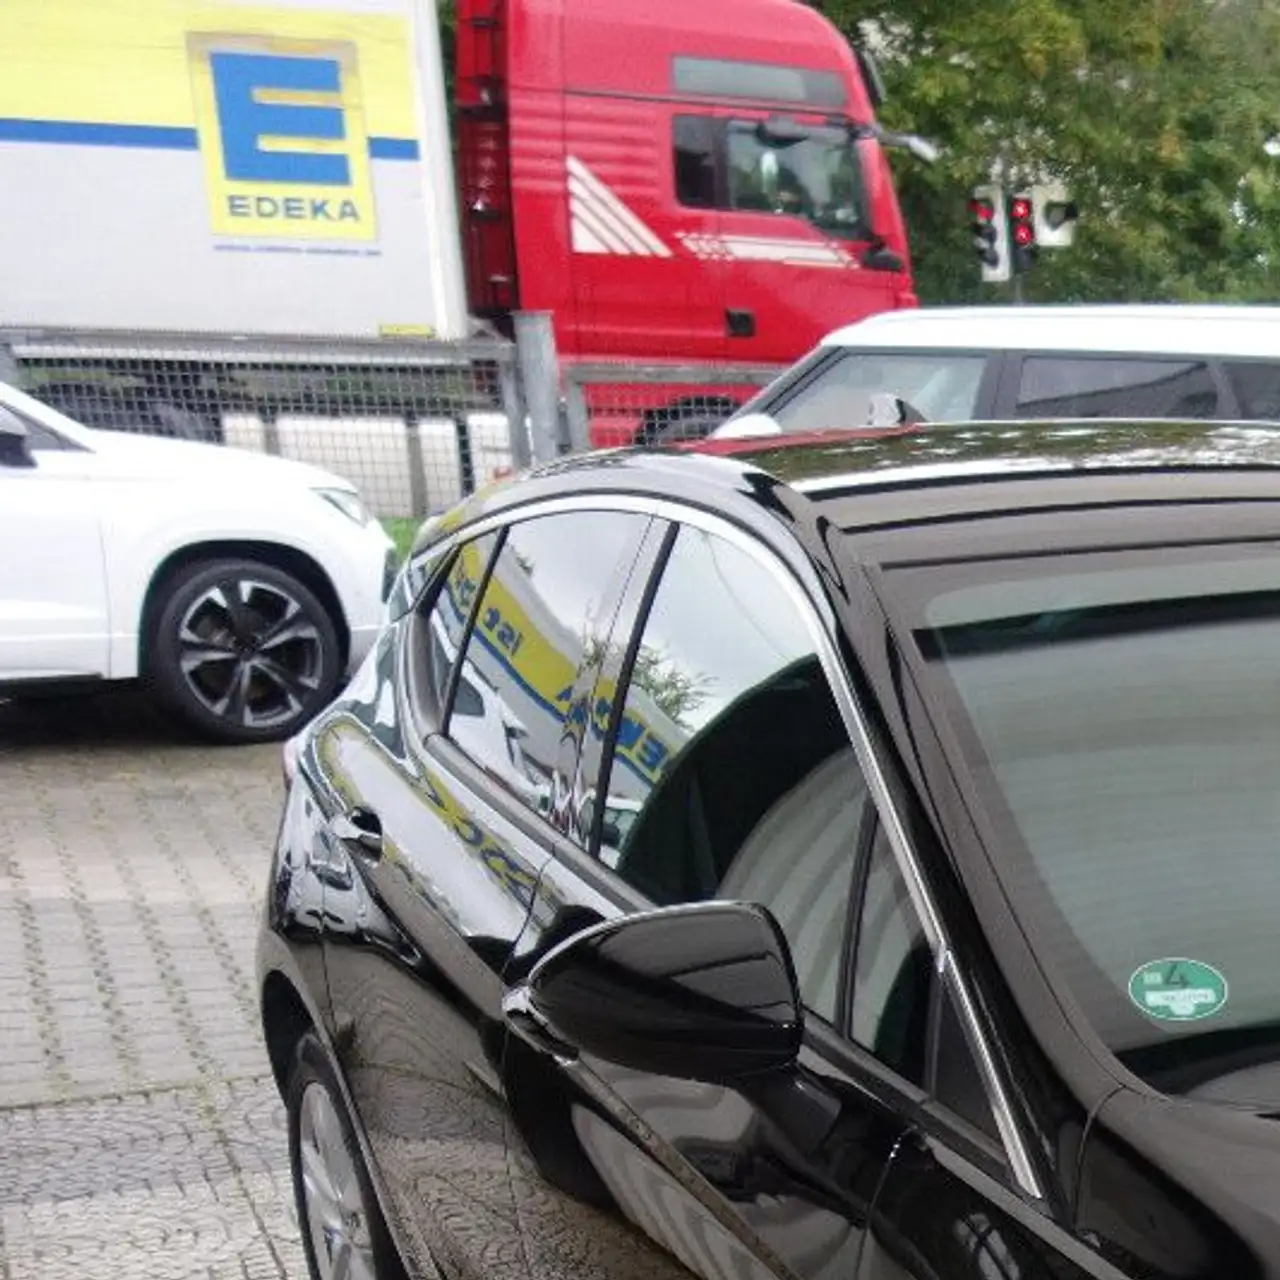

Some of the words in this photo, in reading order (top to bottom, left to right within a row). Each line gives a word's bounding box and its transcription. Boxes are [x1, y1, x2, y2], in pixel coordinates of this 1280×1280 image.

[210, 53, 350, 184] E
[228, 194, 360, 221] EDEKA
[1163, 963, 1189, 988] 4
